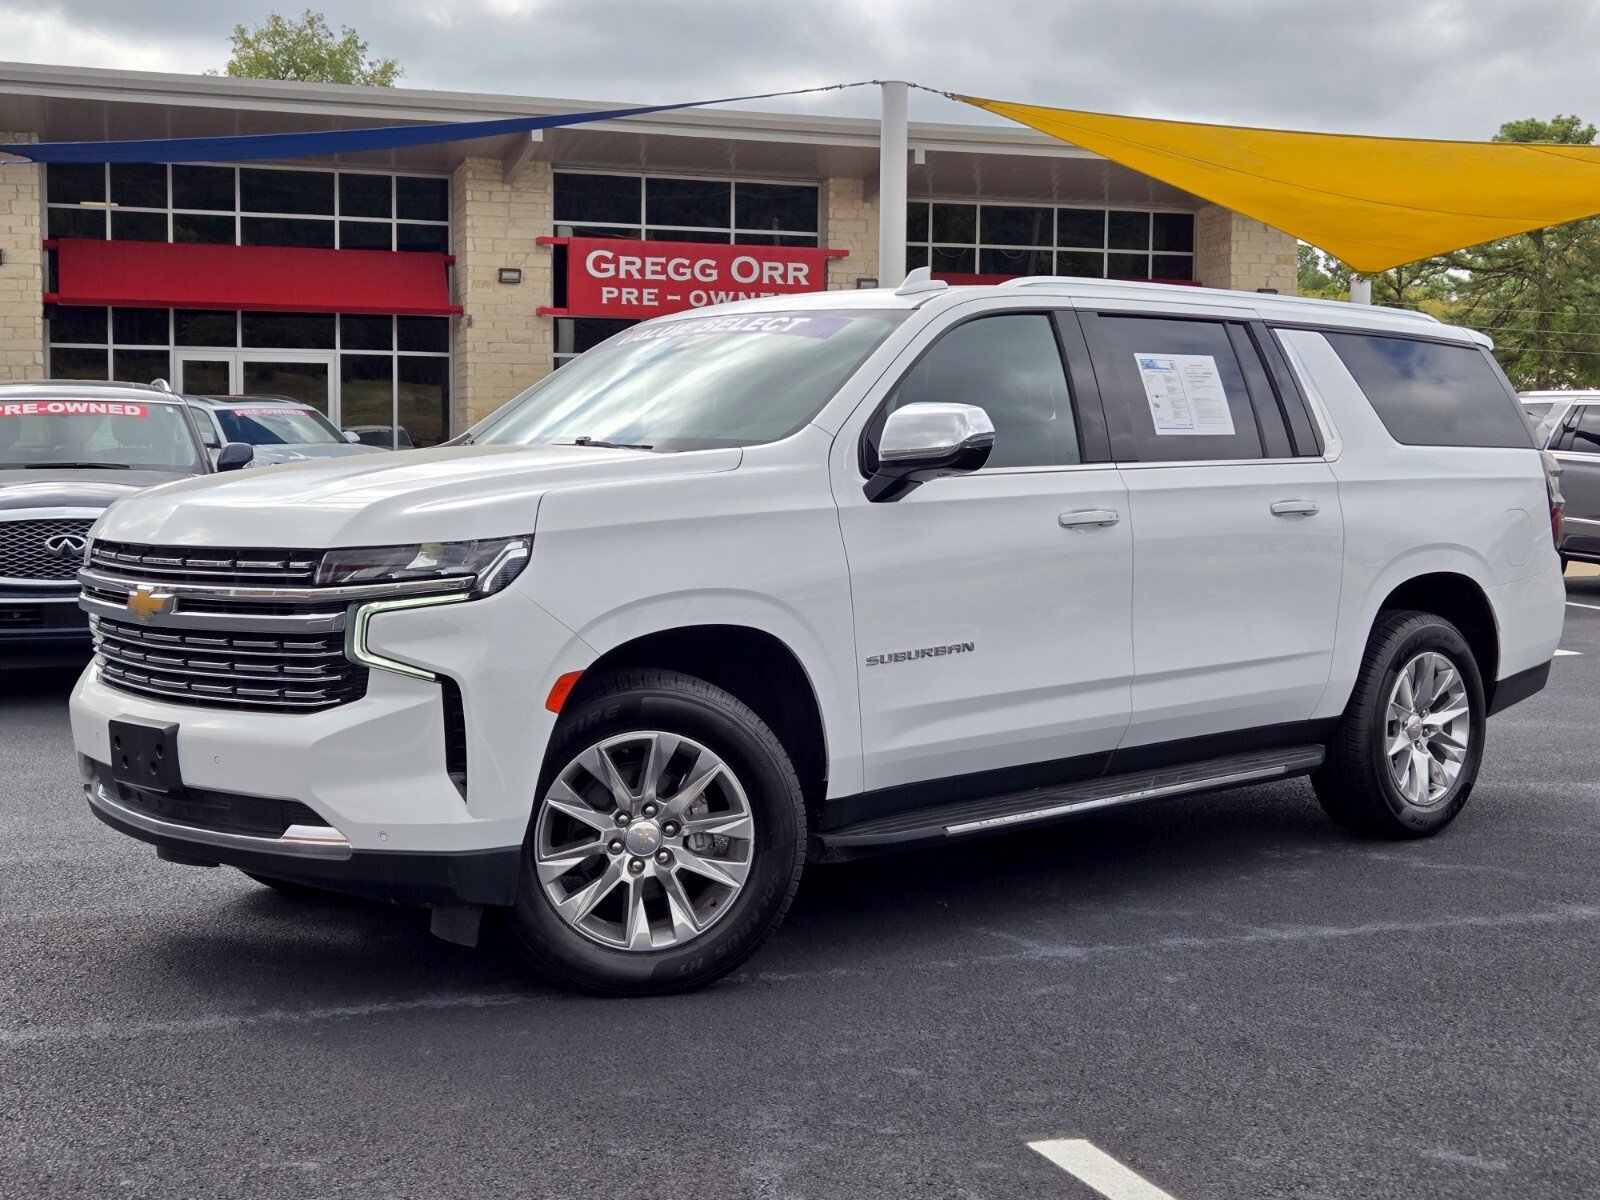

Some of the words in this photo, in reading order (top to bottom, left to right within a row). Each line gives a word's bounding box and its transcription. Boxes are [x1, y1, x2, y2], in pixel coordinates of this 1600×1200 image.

[585, 249, 719, 283] GREGG
[730, 255, 810, 285] ORR
[694, 316, 812, 333] SELECT
[0, 402, 141, 416] RE-OWNED
[865, 642, 975, 667] SUBURBAN
